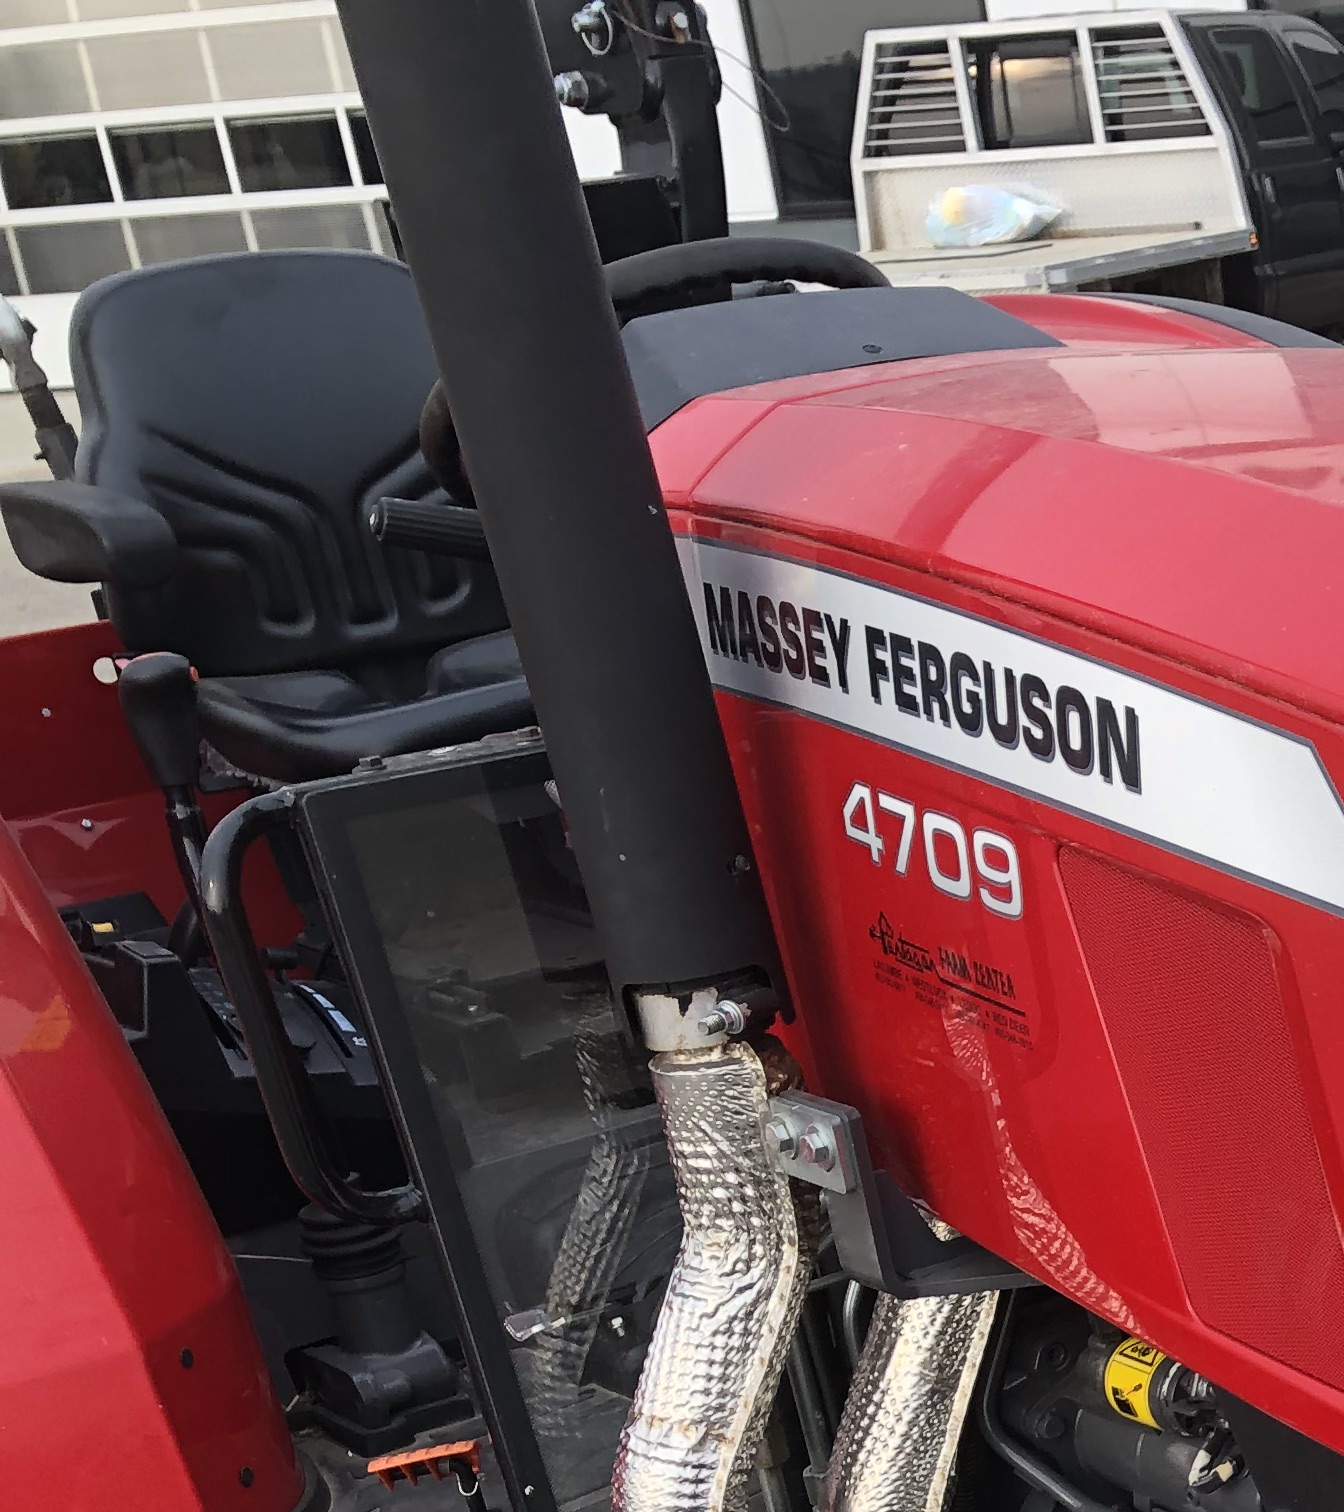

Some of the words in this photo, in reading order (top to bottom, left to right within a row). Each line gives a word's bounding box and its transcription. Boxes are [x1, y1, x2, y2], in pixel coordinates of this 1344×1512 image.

[702, 581, 851, 694] MASSEY
[864, 624, 1142, 795] FERGUSON
[842, 780, 1024, 920] 4709
